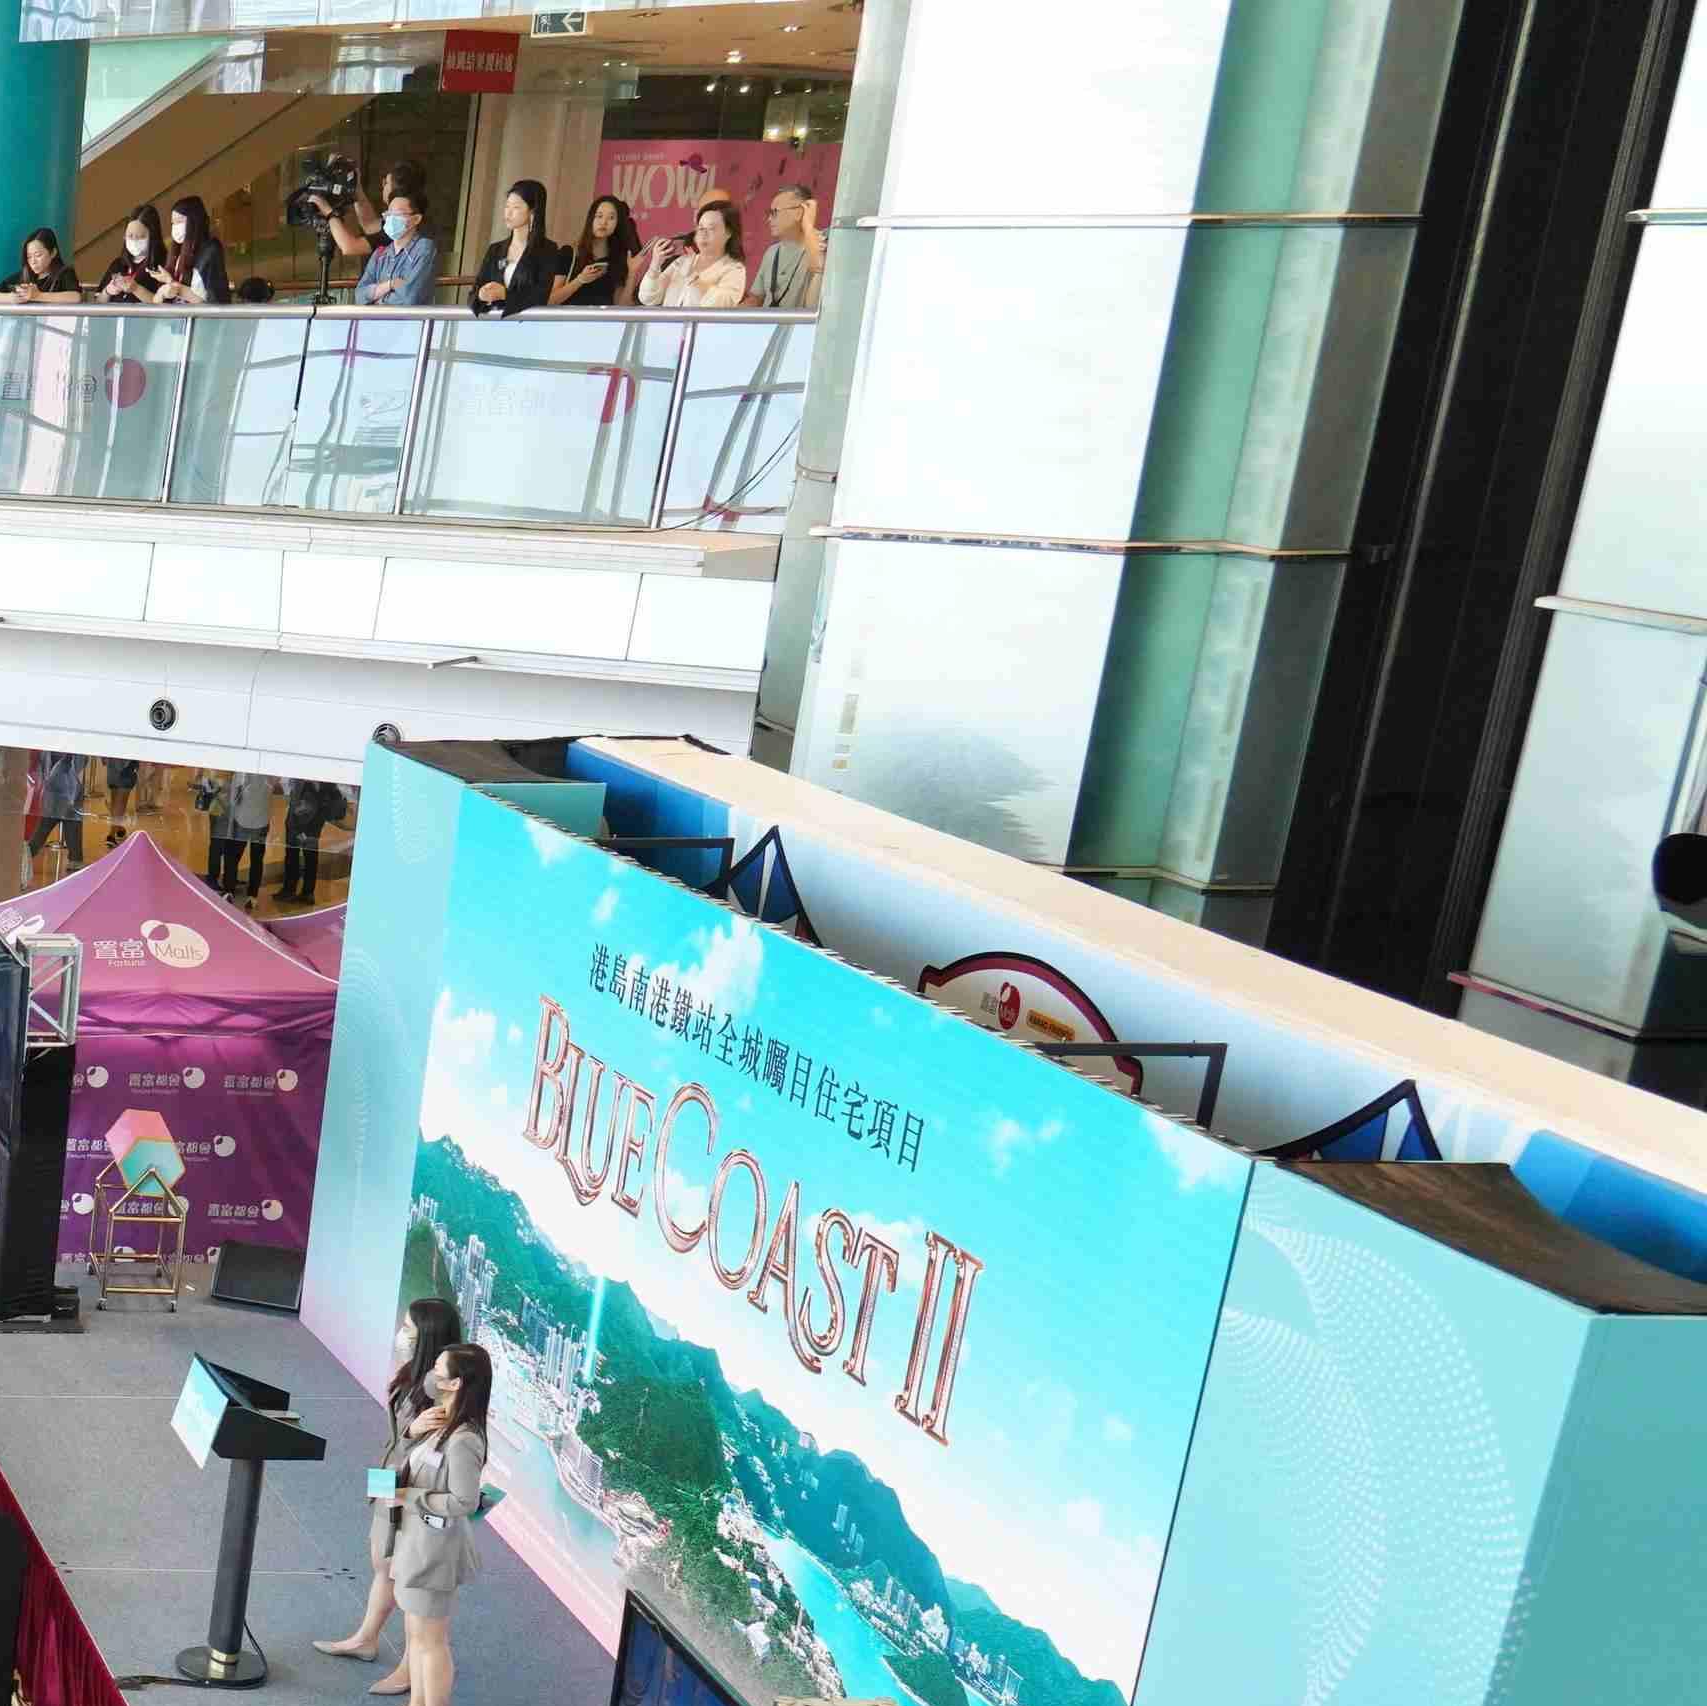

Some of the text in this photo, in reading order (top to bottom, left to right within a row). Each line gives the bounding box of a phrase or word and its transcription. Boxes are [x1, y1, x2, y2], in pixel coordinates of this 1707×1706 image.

[93, 938, 146, 960] 置富
[154, 942, 205, 961] Malls
[589, 944, 924, 1172] 港島南港鐵站全城矚目住宅項目
[896, 1231, 985, 1447] II
